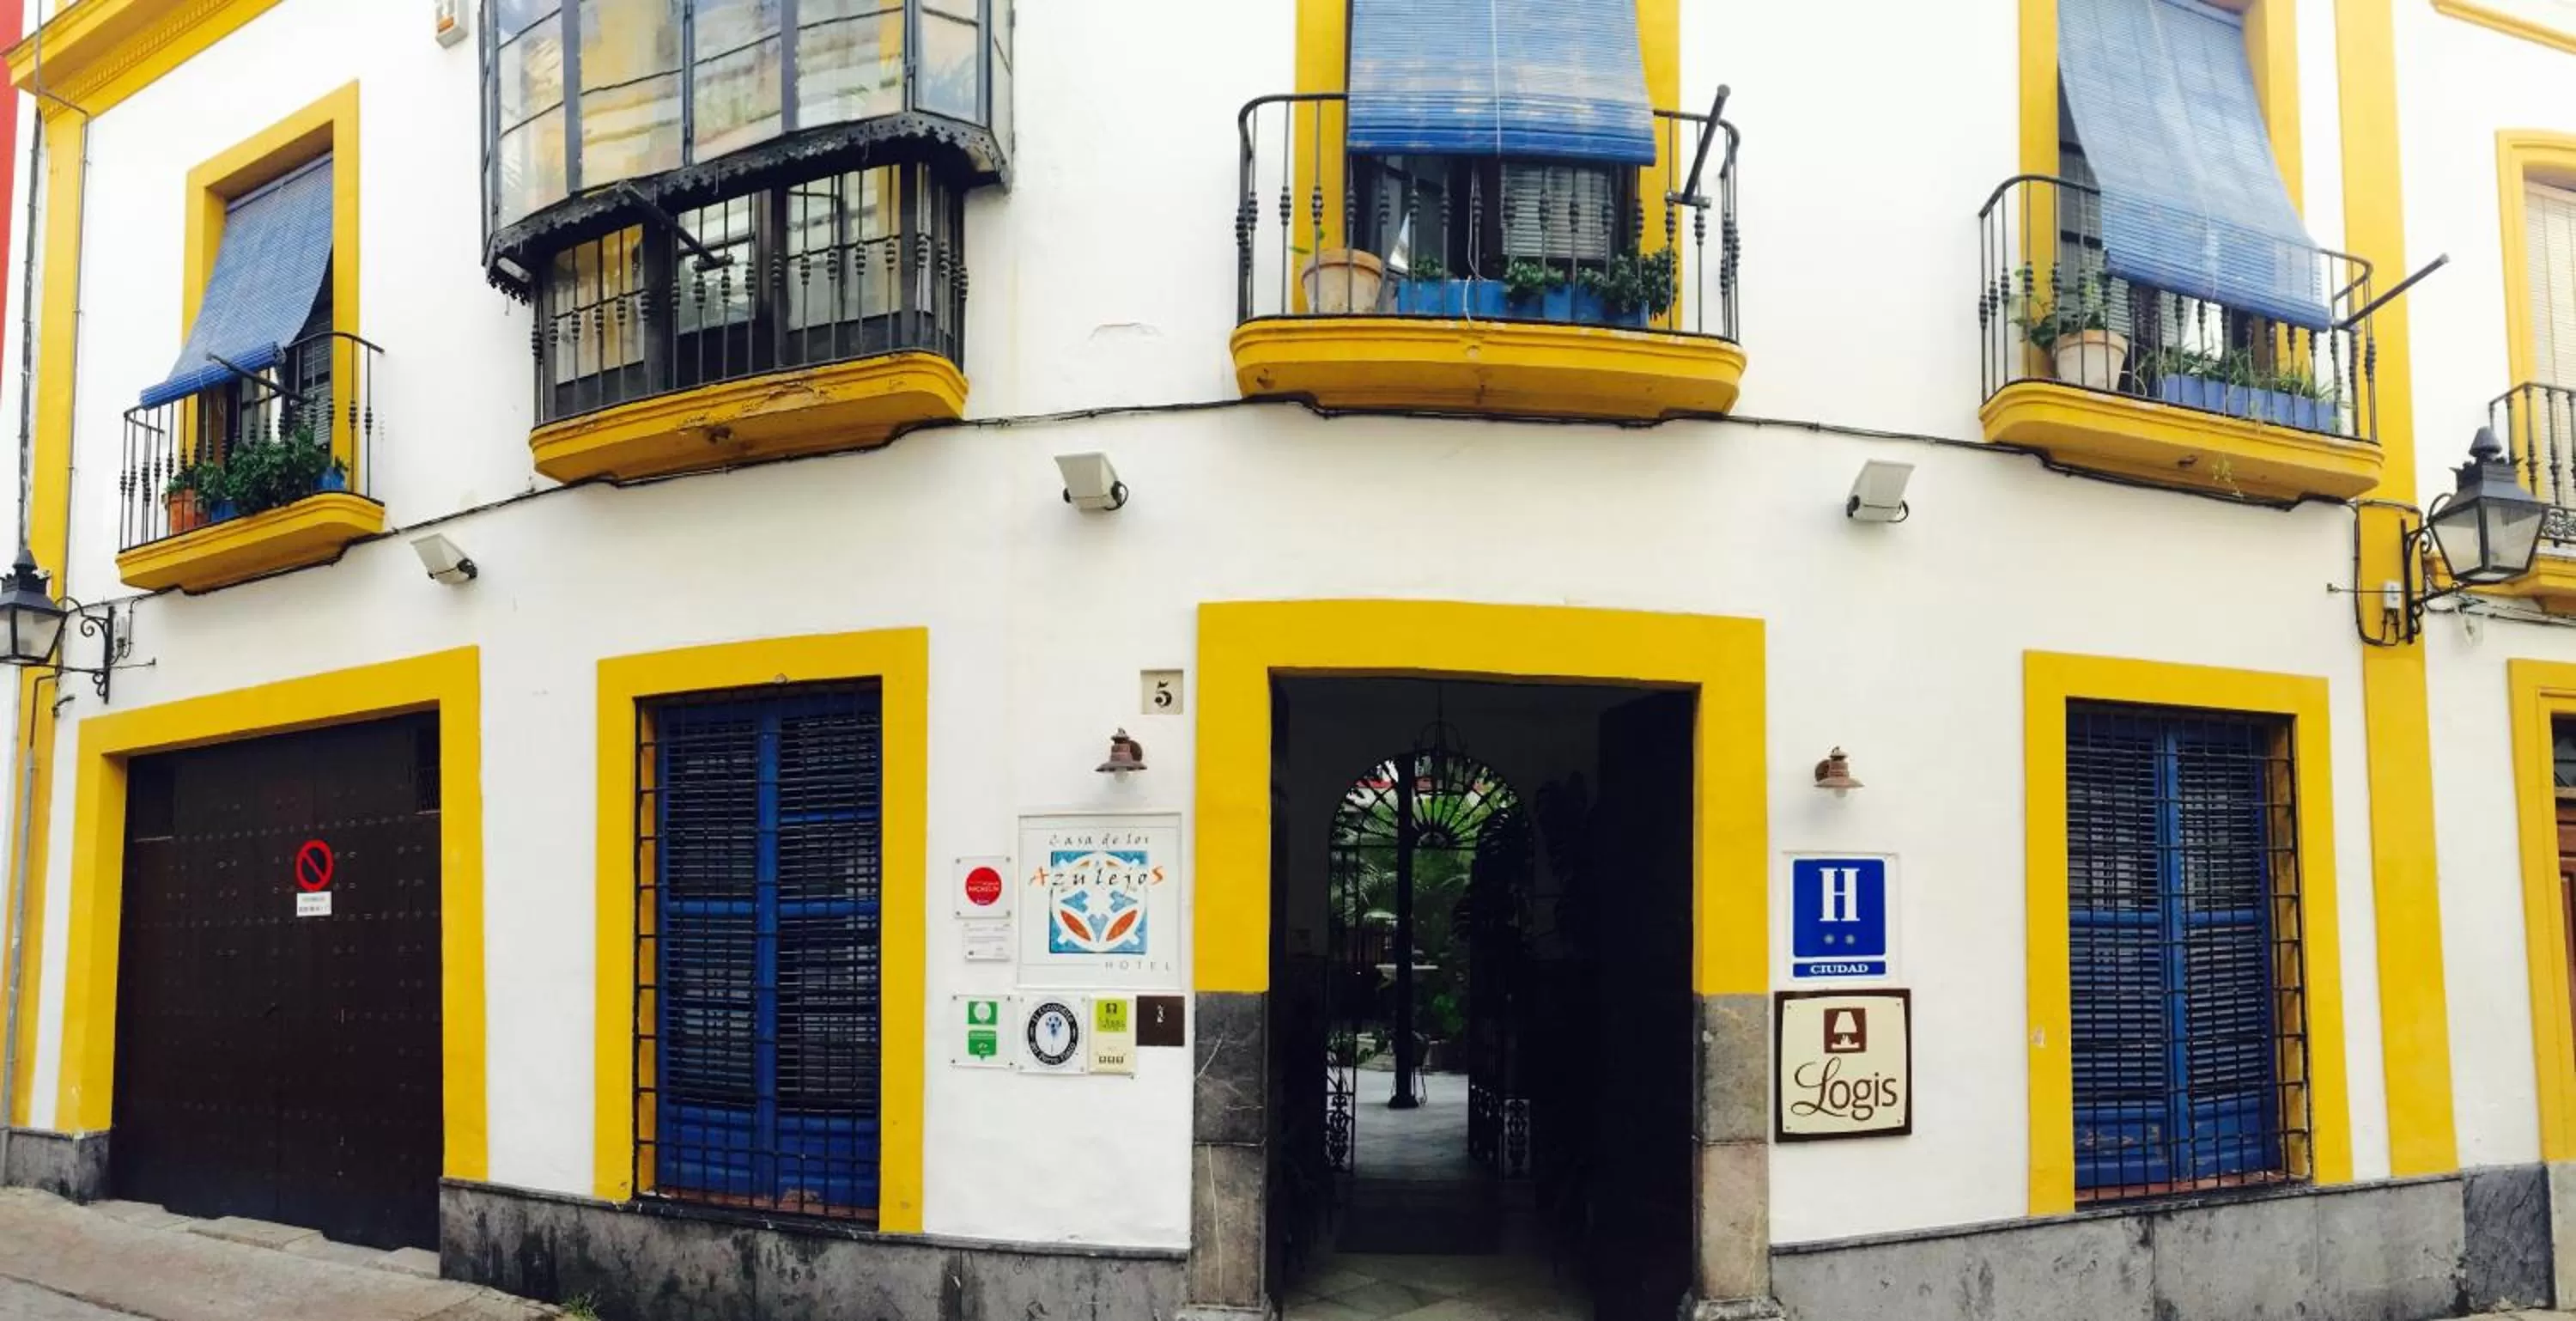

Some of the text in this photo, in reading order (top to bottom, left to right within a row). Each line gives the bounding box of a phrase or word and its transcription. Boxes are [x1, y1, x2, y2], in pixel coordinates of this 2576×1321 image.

[1155, 680, 1172, 708] 5
[1048, 832, 1150, 848] Casa de los
[1819, 867, 1861, 922] H
[1105, 960, 1173, 972] HOTEL
[1810, 964, 1869, 974] CIUDAD
[1790, 1056, 1898, 1121] Logis
